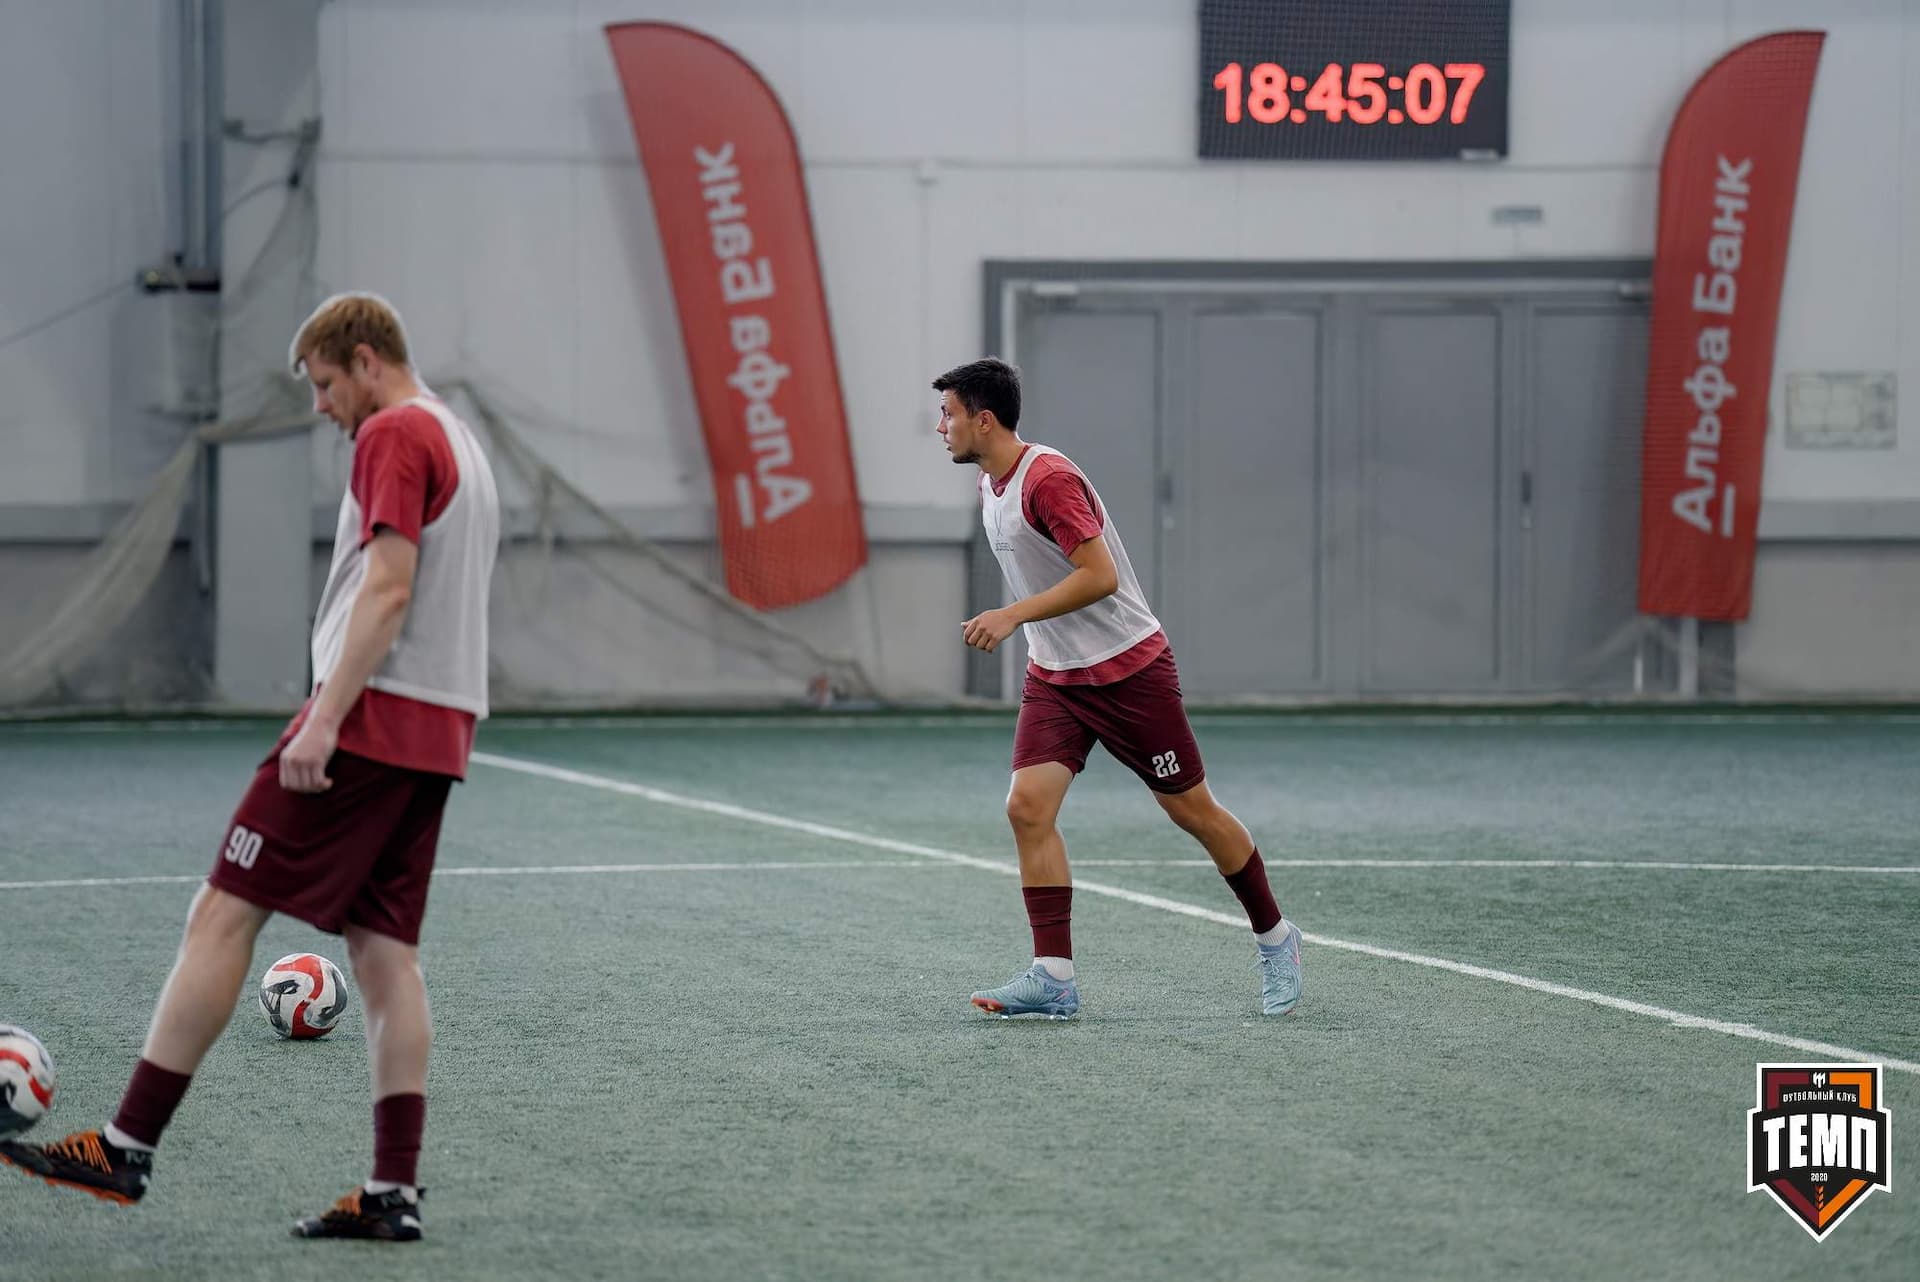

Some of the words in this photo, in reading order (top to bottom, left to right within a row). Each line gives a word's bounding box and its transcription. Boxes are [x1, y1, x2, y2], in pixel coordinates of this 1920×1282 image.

[1214, 62, 1485, 125] 18:45:07
[1692, 155, 1752, 314] Банк
[1672, 327, 1735, 531] Альфа
[1151, 750, 1181, 779] 22
[224, 825, 264, 870] 90
